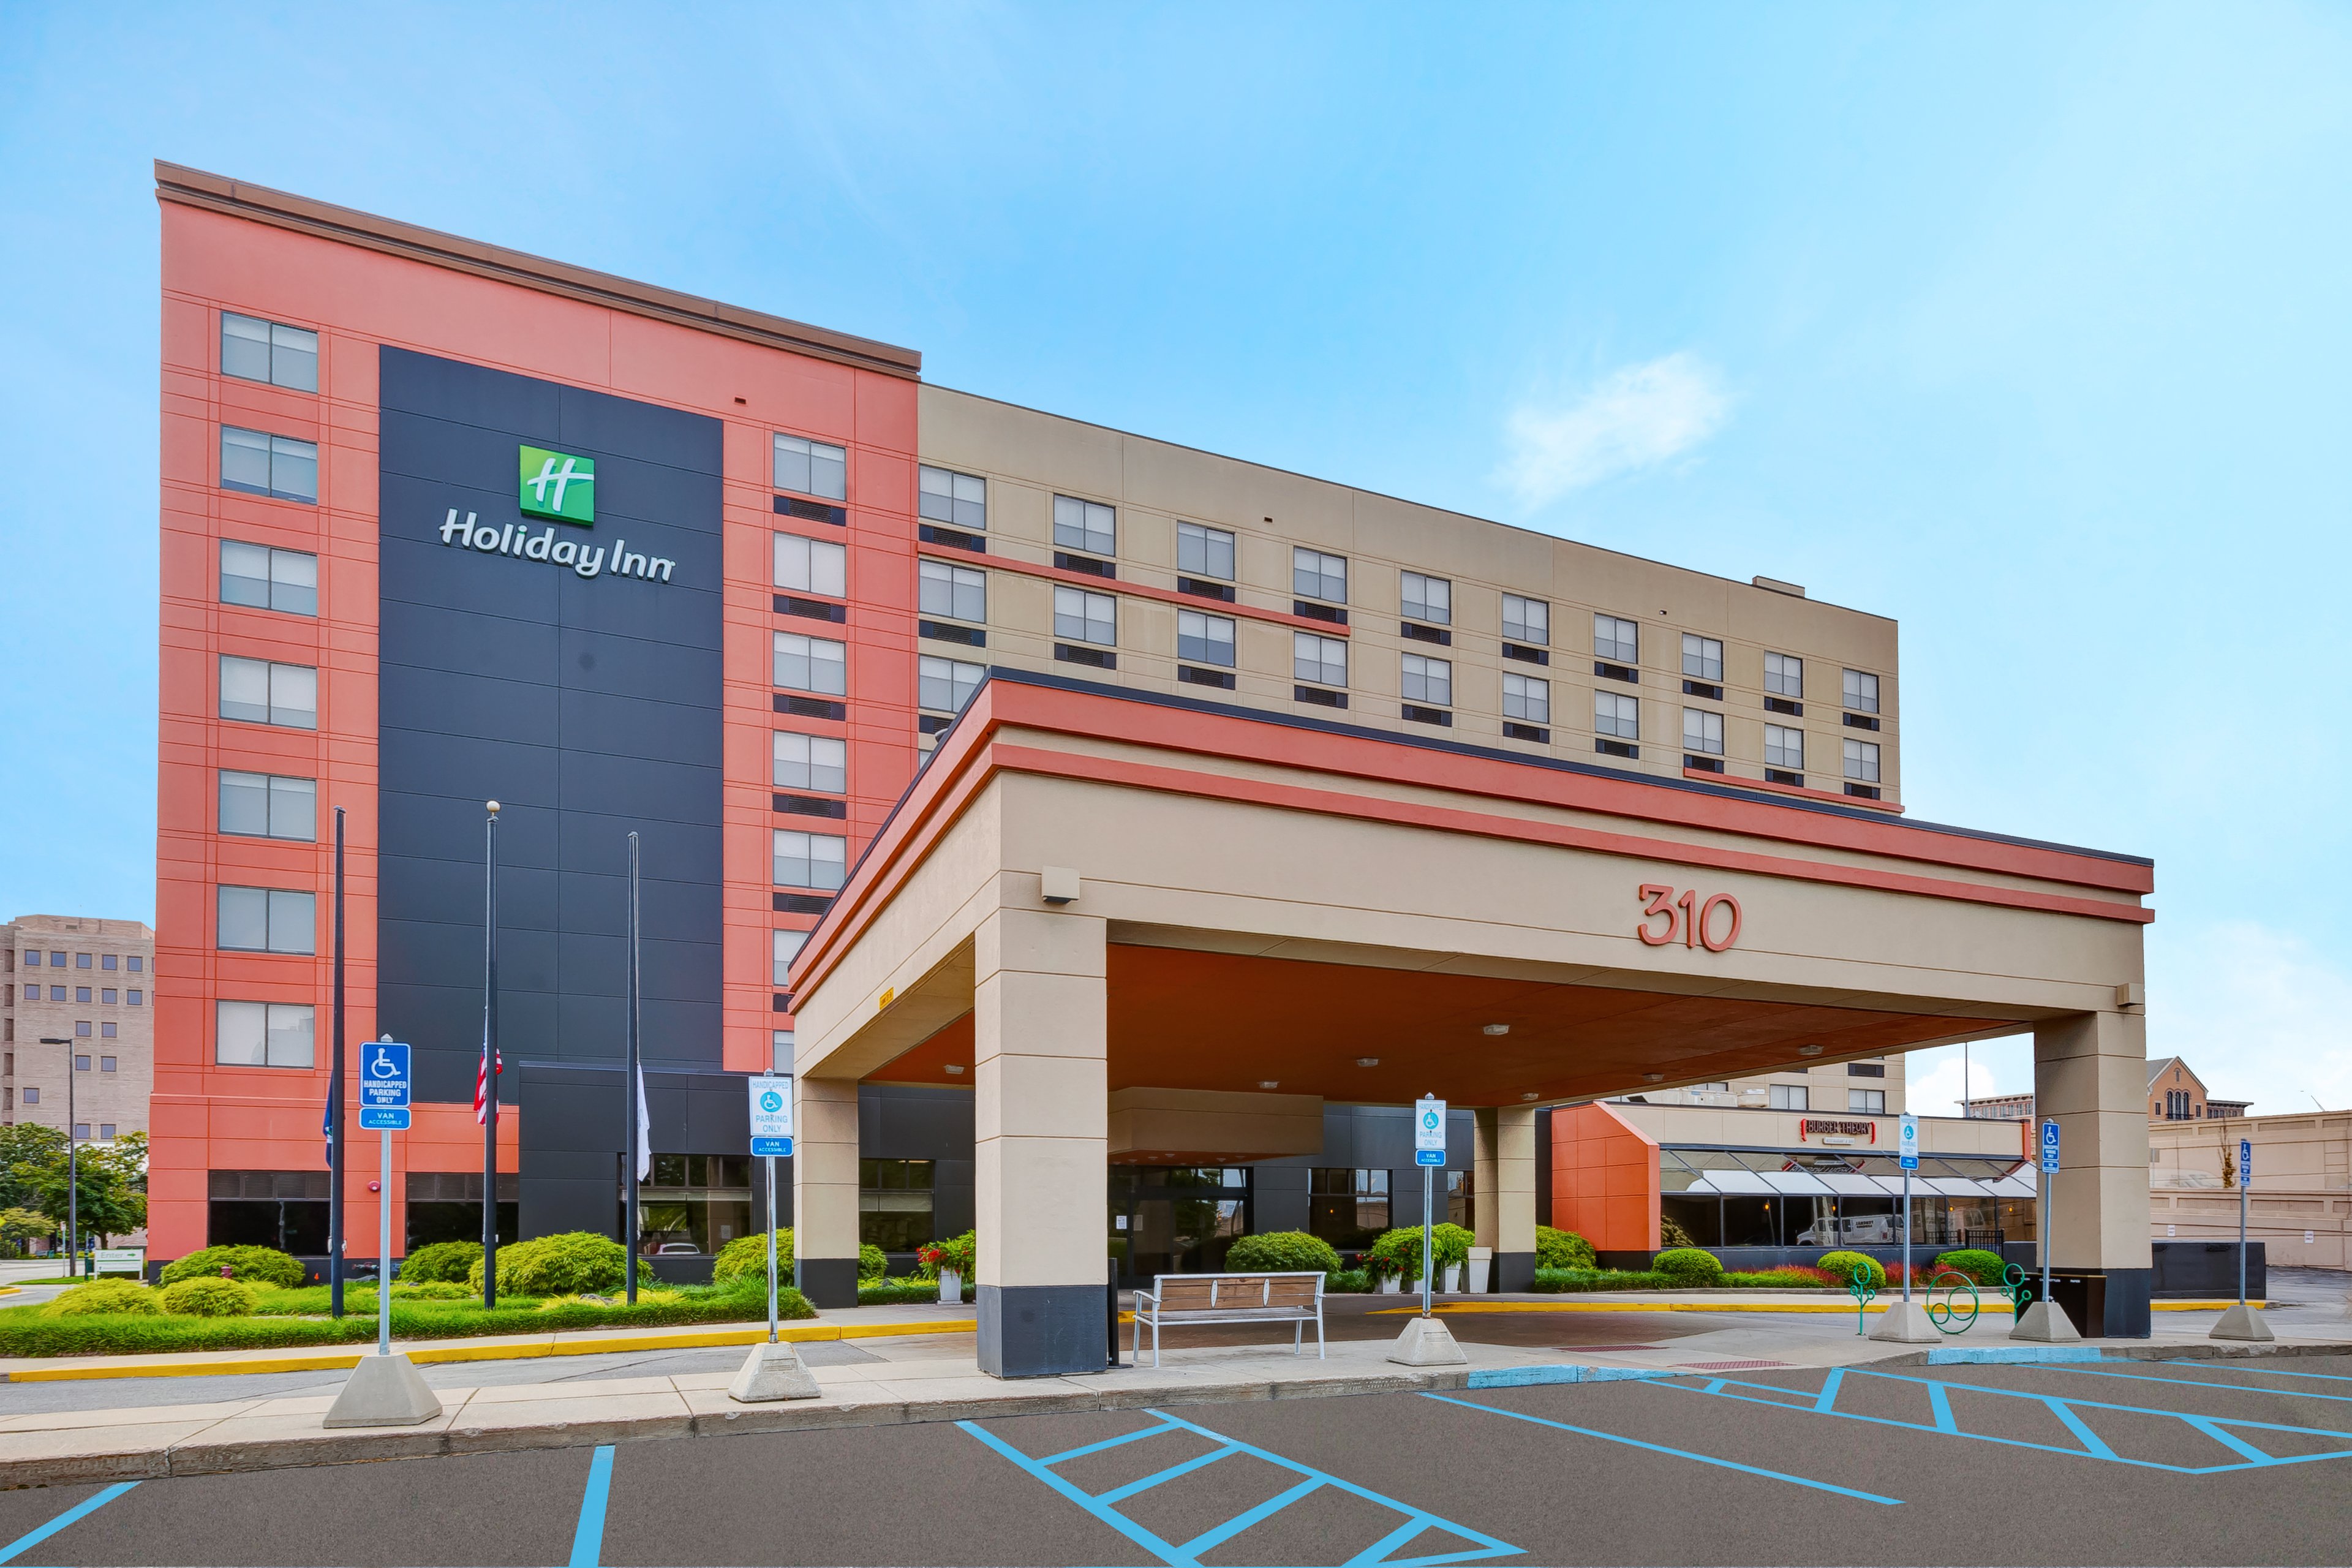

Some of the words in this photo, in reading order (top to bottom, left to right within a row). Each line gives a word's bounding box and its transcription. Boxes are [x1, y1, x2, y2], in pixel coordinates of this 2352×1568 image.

[439, 507, 605, 578] Holiday
[609, 538, 672, 582] Inn
[1637, 883, 1742, 952] 310
[364, 1080, 407, 1089] HANDICAPPED
[752, 1080, 789, 1089] HANDICAPPED
[1809, 1120, 1839, 1133] BURGER
[1839, 1121, 1870, 1134] THEORY
